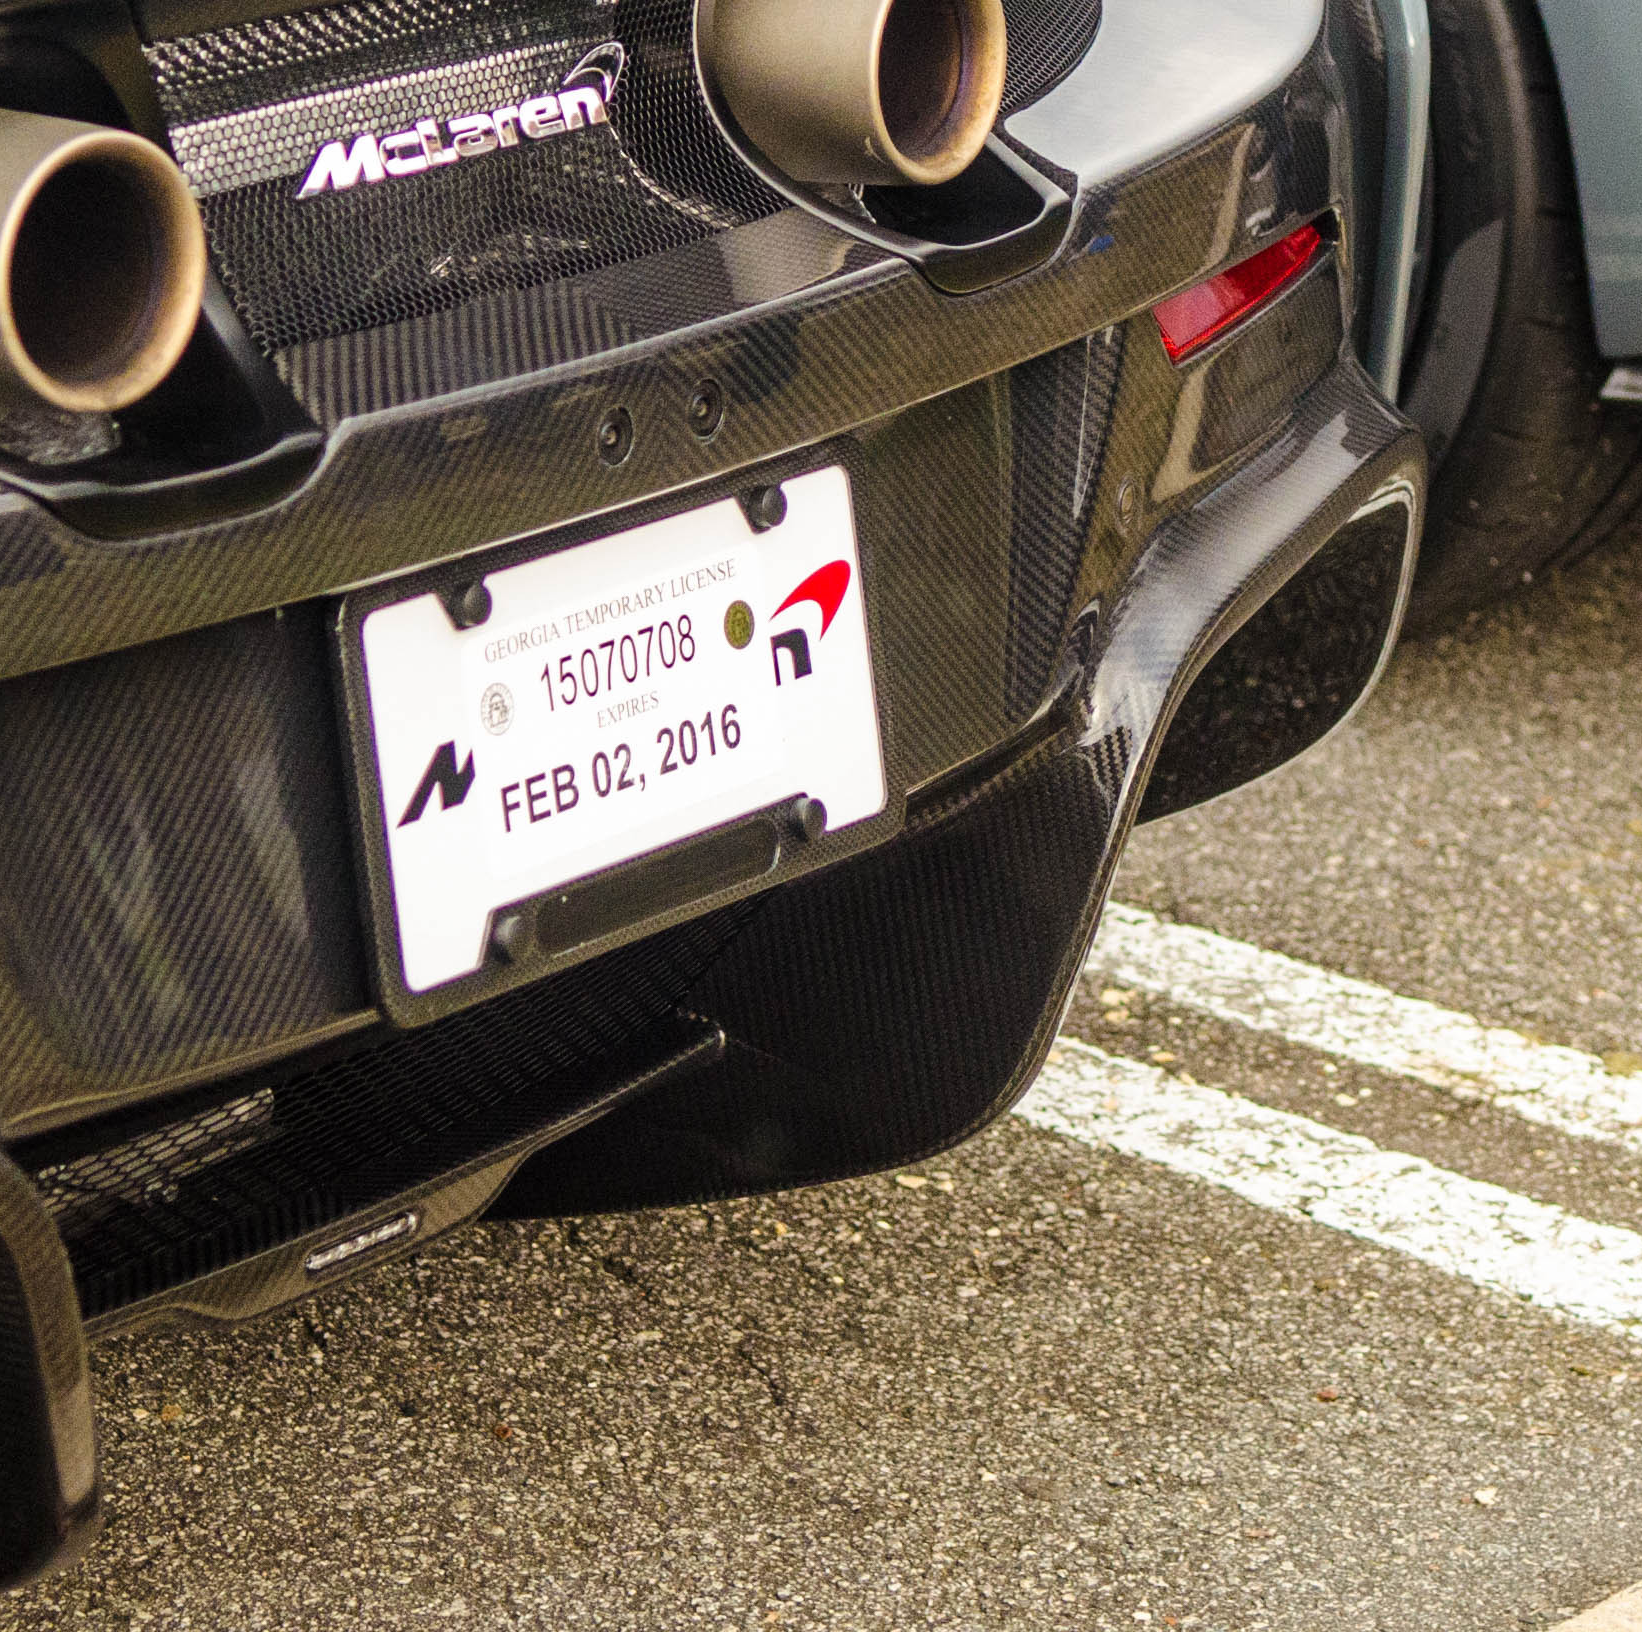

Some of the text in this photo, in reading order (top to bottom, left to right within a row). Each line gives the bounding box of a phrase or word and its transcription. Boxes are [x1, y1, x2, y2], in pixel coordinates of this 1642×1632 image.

[296, 85, 607, 200] McLaren
[484, 558, 736, 664] GEORGIA TEMPORARY LICENSE
[540, 614, 696, 712] 15070708
[597, 690, 660, 729] EXPIRES
[500, 763, 580, 833] FEB
[591, 743, 647, 798] 02,
[656, 703, 742, 775] 2016
